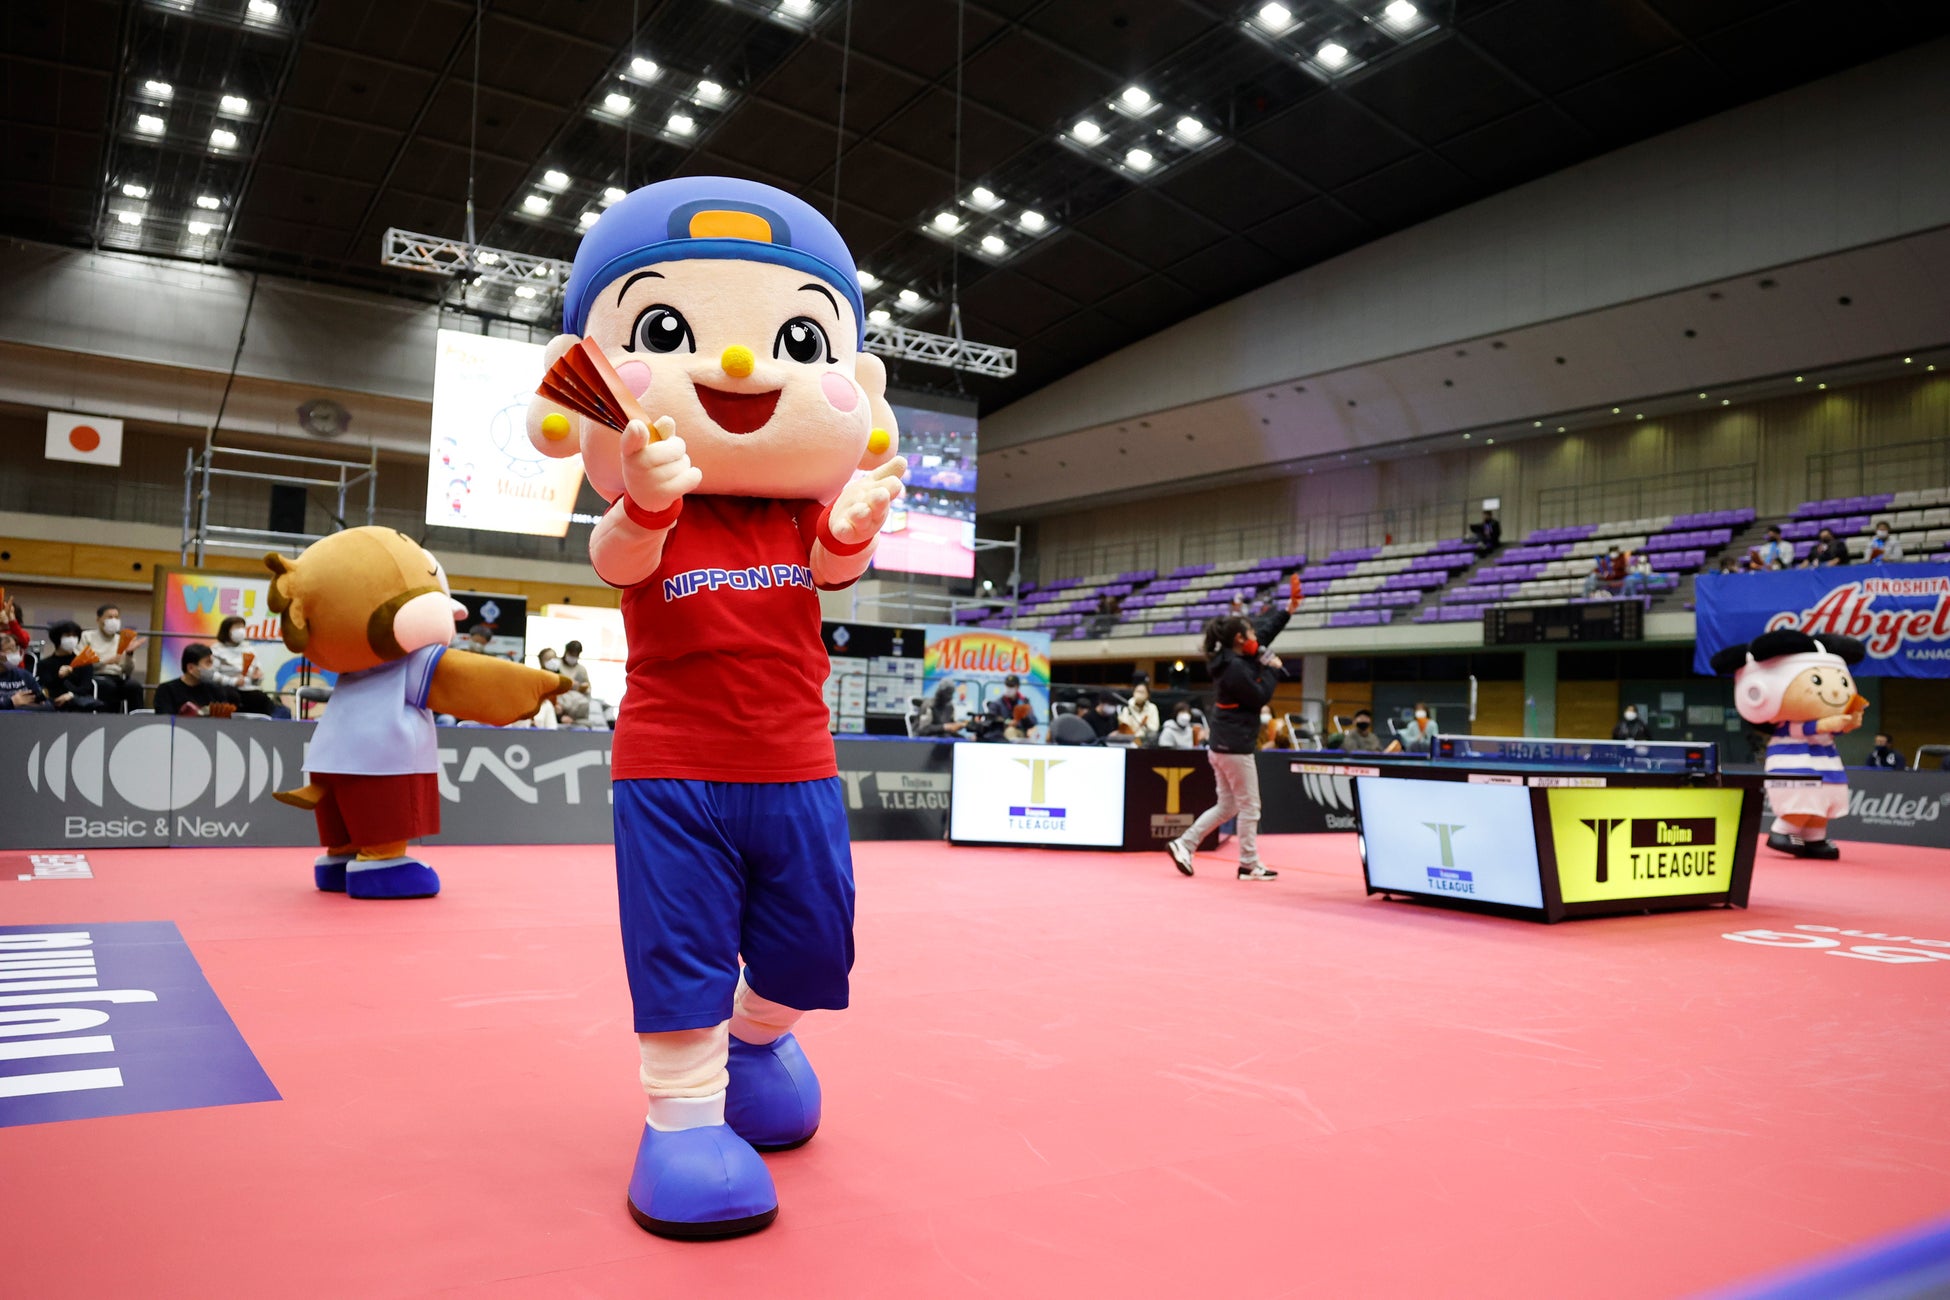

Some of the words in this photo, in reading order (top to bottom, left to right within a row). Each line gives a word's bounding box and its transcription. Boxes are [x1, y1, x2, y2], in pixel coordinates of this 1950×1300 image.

[663, 565, 772, 602] NIPPON
[1864, 577, 1950, 595] KINOSHITA
[935, 637, 1031, 674] Mallets
[878, 792, 950, 809] T.LEAGU
[65, 816, 147, 838] Basic
[154, 817, 170, 837] &
[177, 816, 250, 838] New
[1656, 820, 1693, 846] Nojima
[1630, 850, 1717, 880] T.LEAGUE
